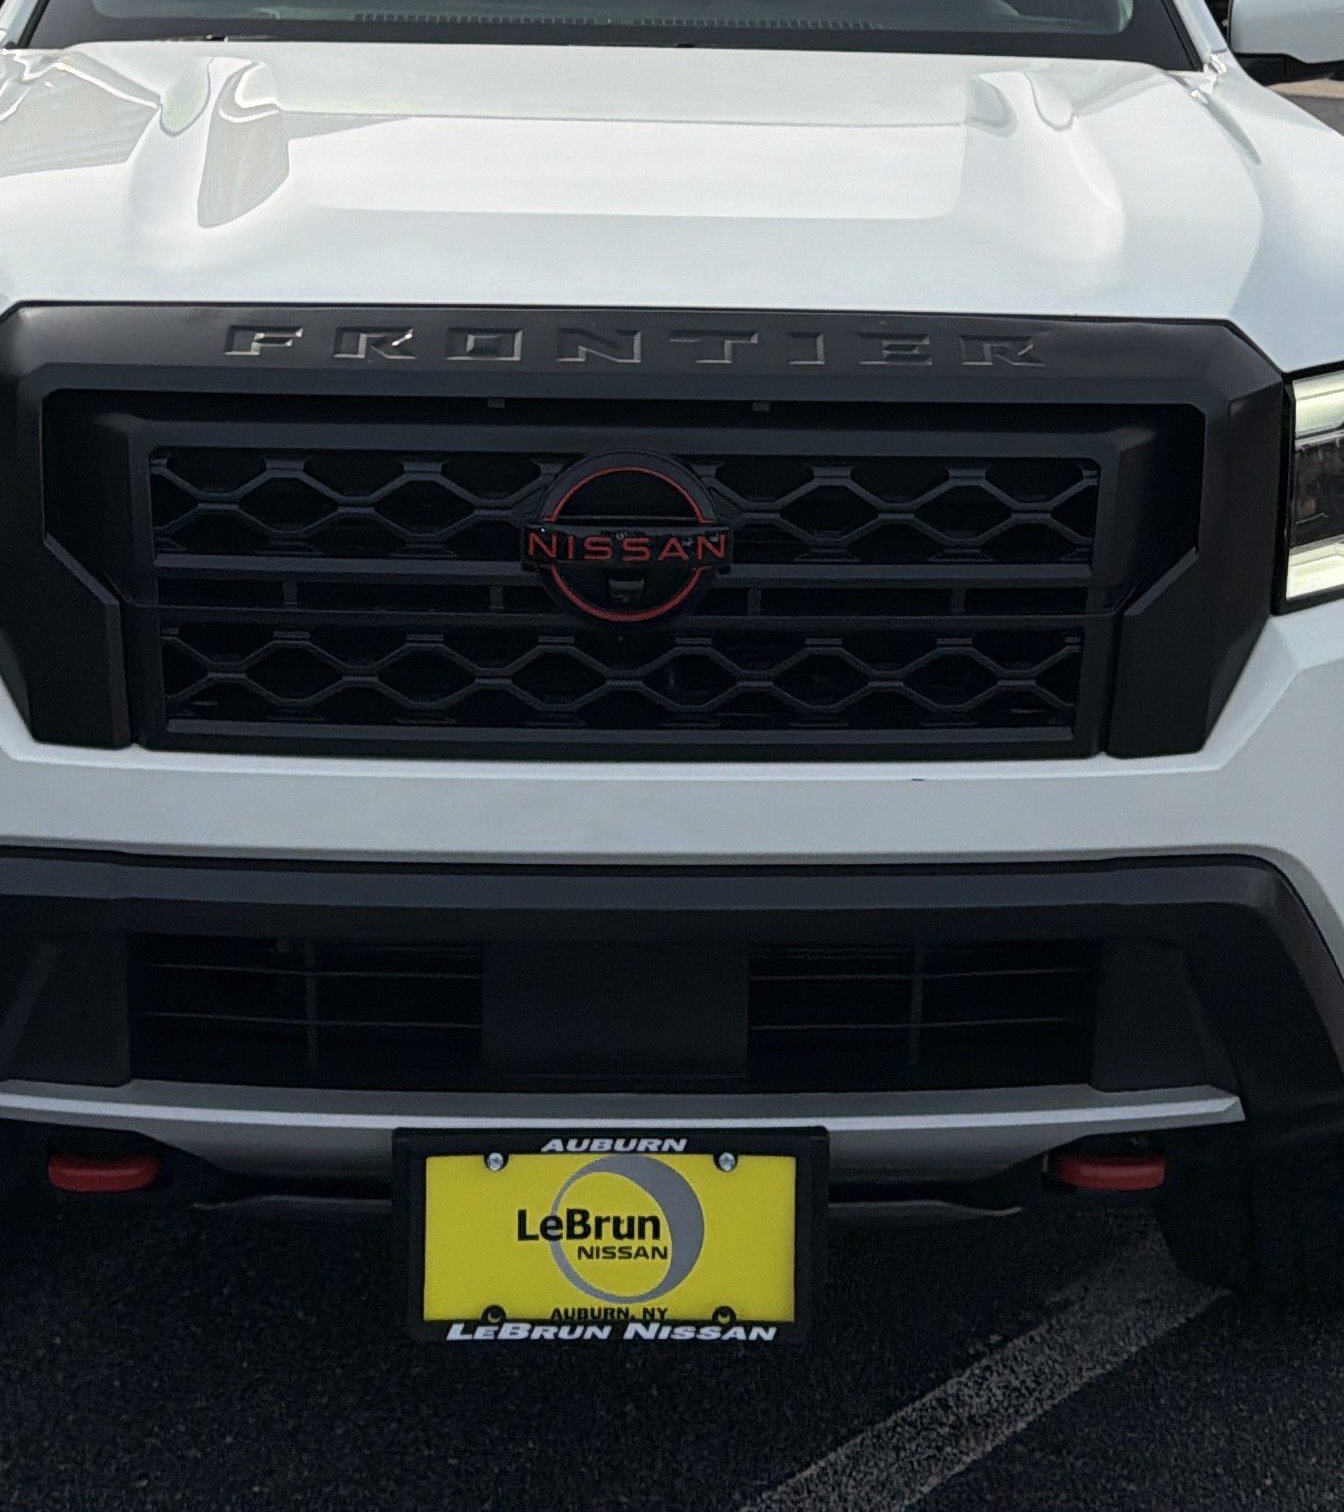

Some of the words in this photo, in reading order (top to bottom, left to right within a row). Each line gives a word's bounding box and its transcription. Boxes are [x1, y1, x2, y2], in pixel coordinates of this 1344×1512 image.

[223, 324, 1048, 368] FRONTIER
[526, 529, 727, 563] NISSAN
[541, 1138, 688, 1153] AUBURN
[517, 1208, 661, 1241] LeBrun
[577, 1245, 668, 1260] NISSAN
[642, 1307, 669, 1320] NY
